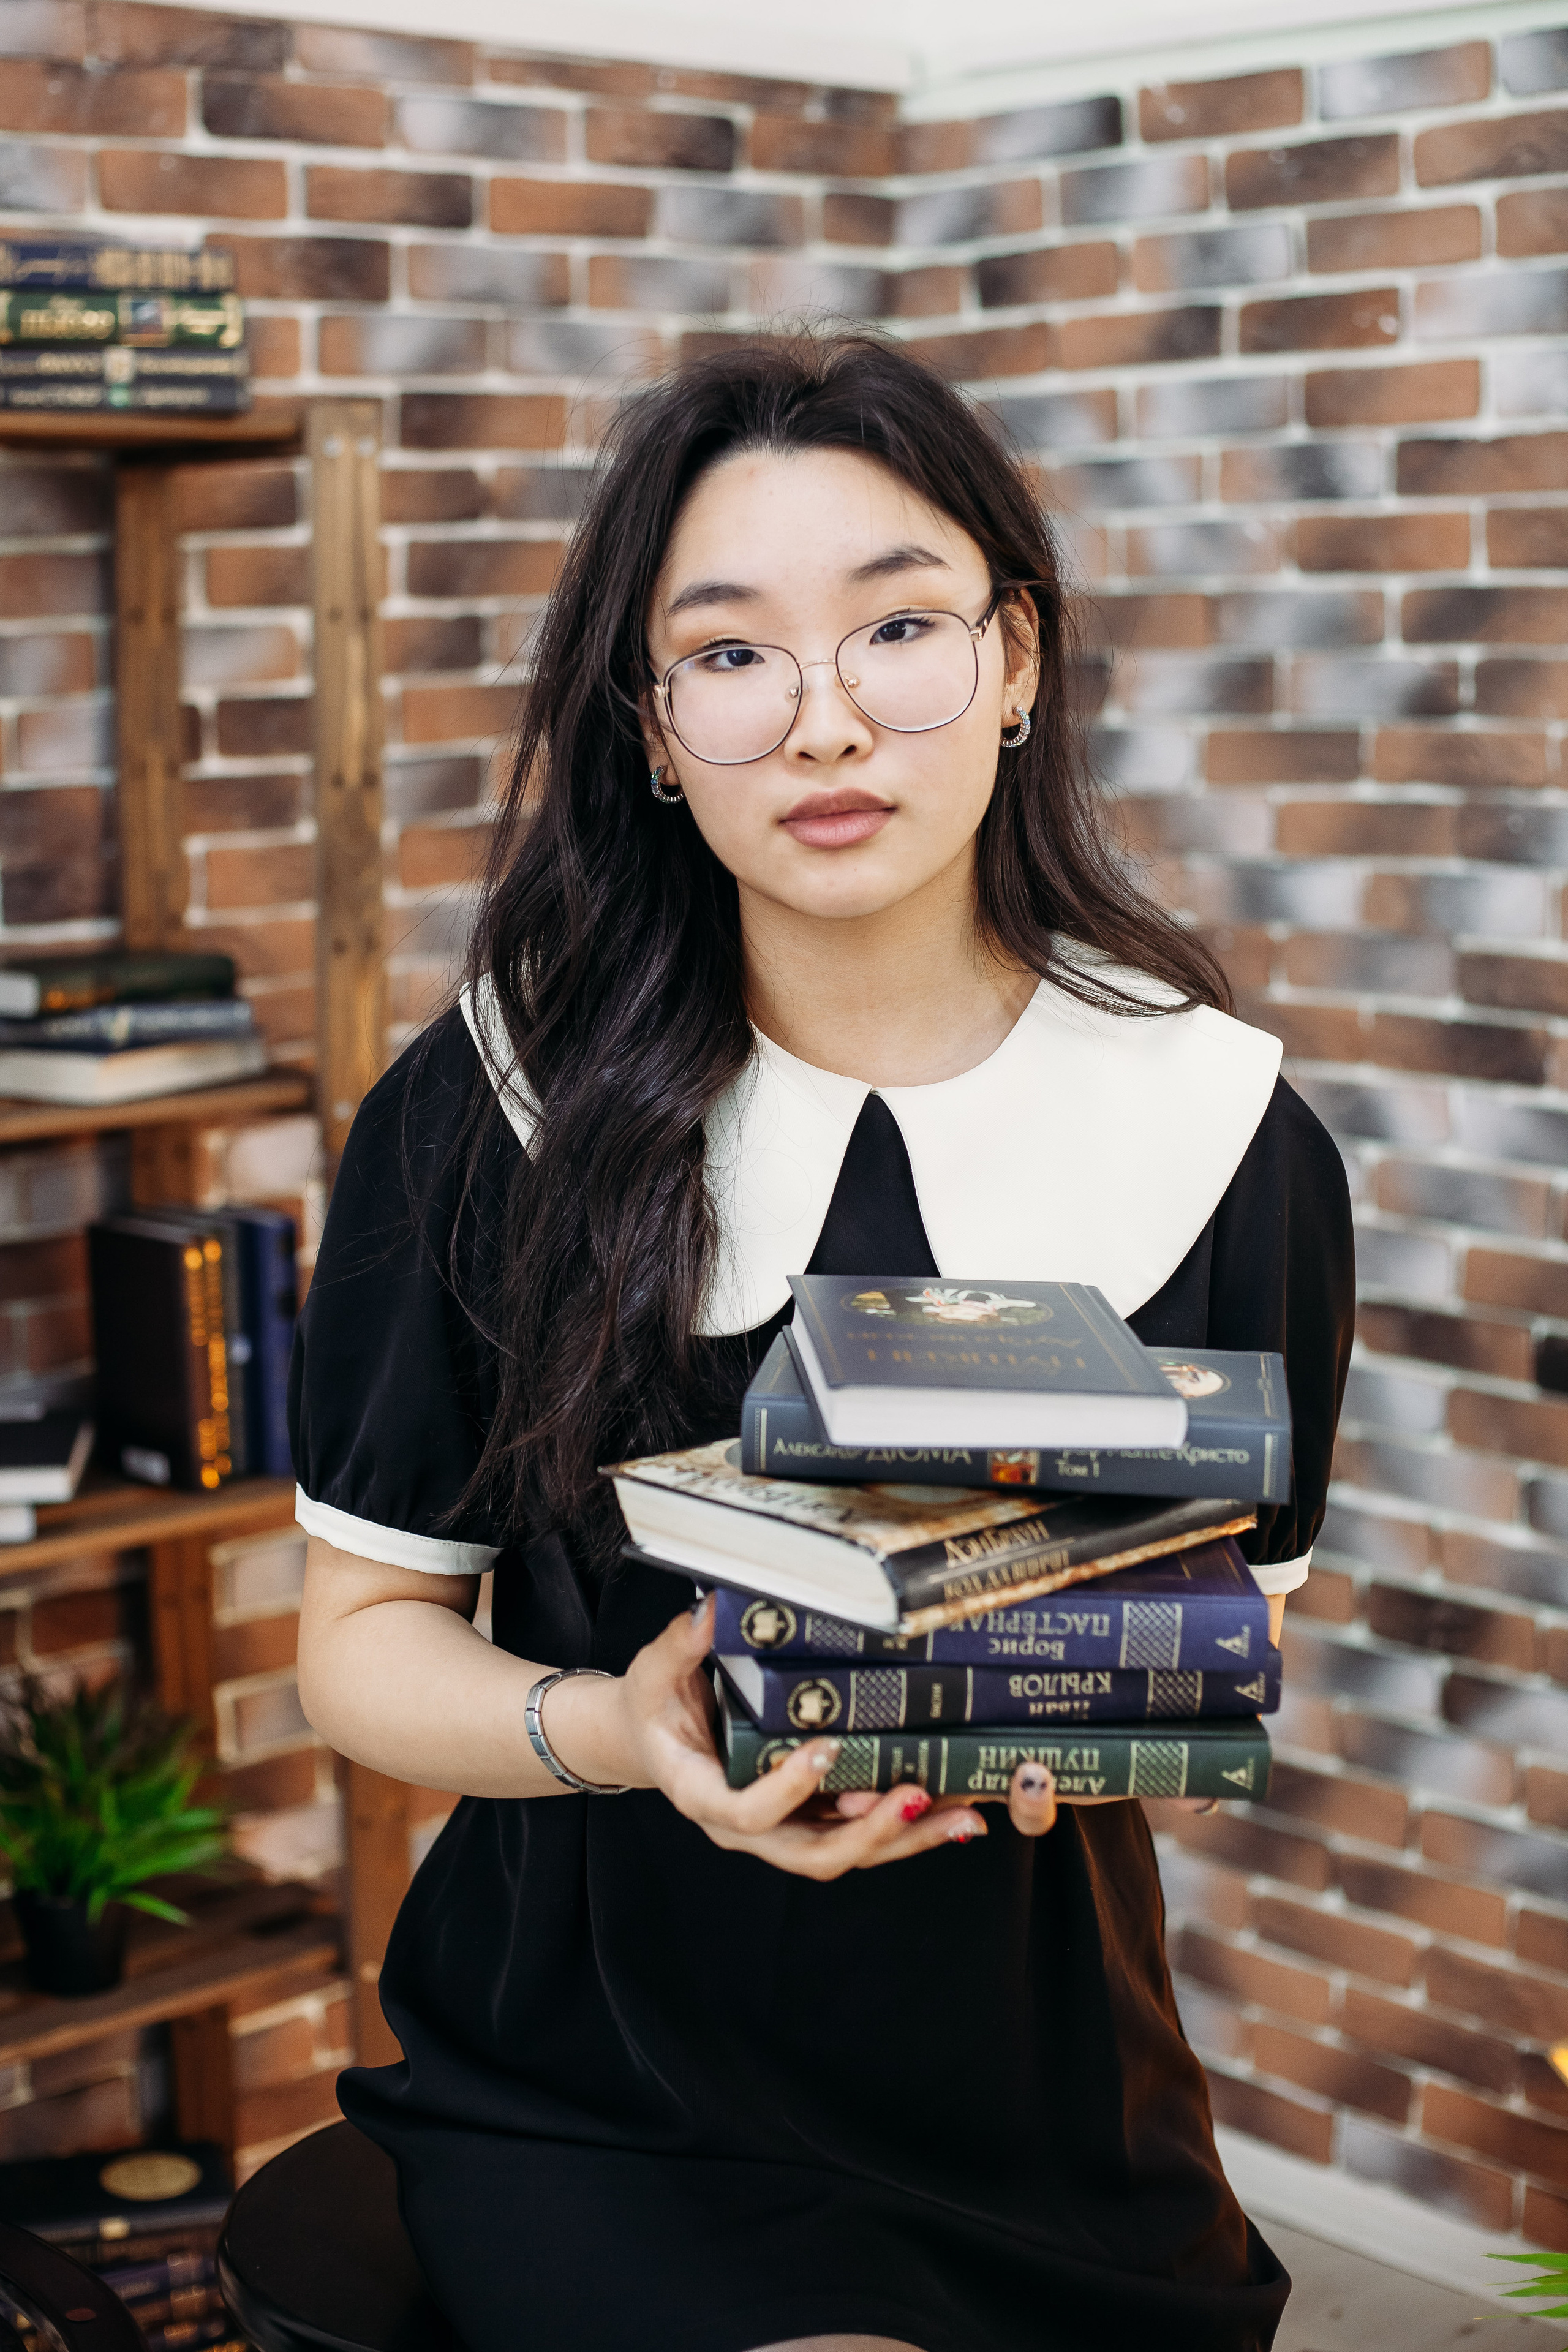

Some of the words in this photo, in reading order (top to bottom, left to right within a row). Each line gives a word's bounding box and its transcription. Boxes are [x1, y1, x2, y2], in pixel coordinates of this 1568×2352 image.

[988, 1634, 1065, 1660] Борис
[1009, 1672, 1112, 1697] КРЫЛОВ
[978, 1746, 1100, 1771] ПУШКИН
